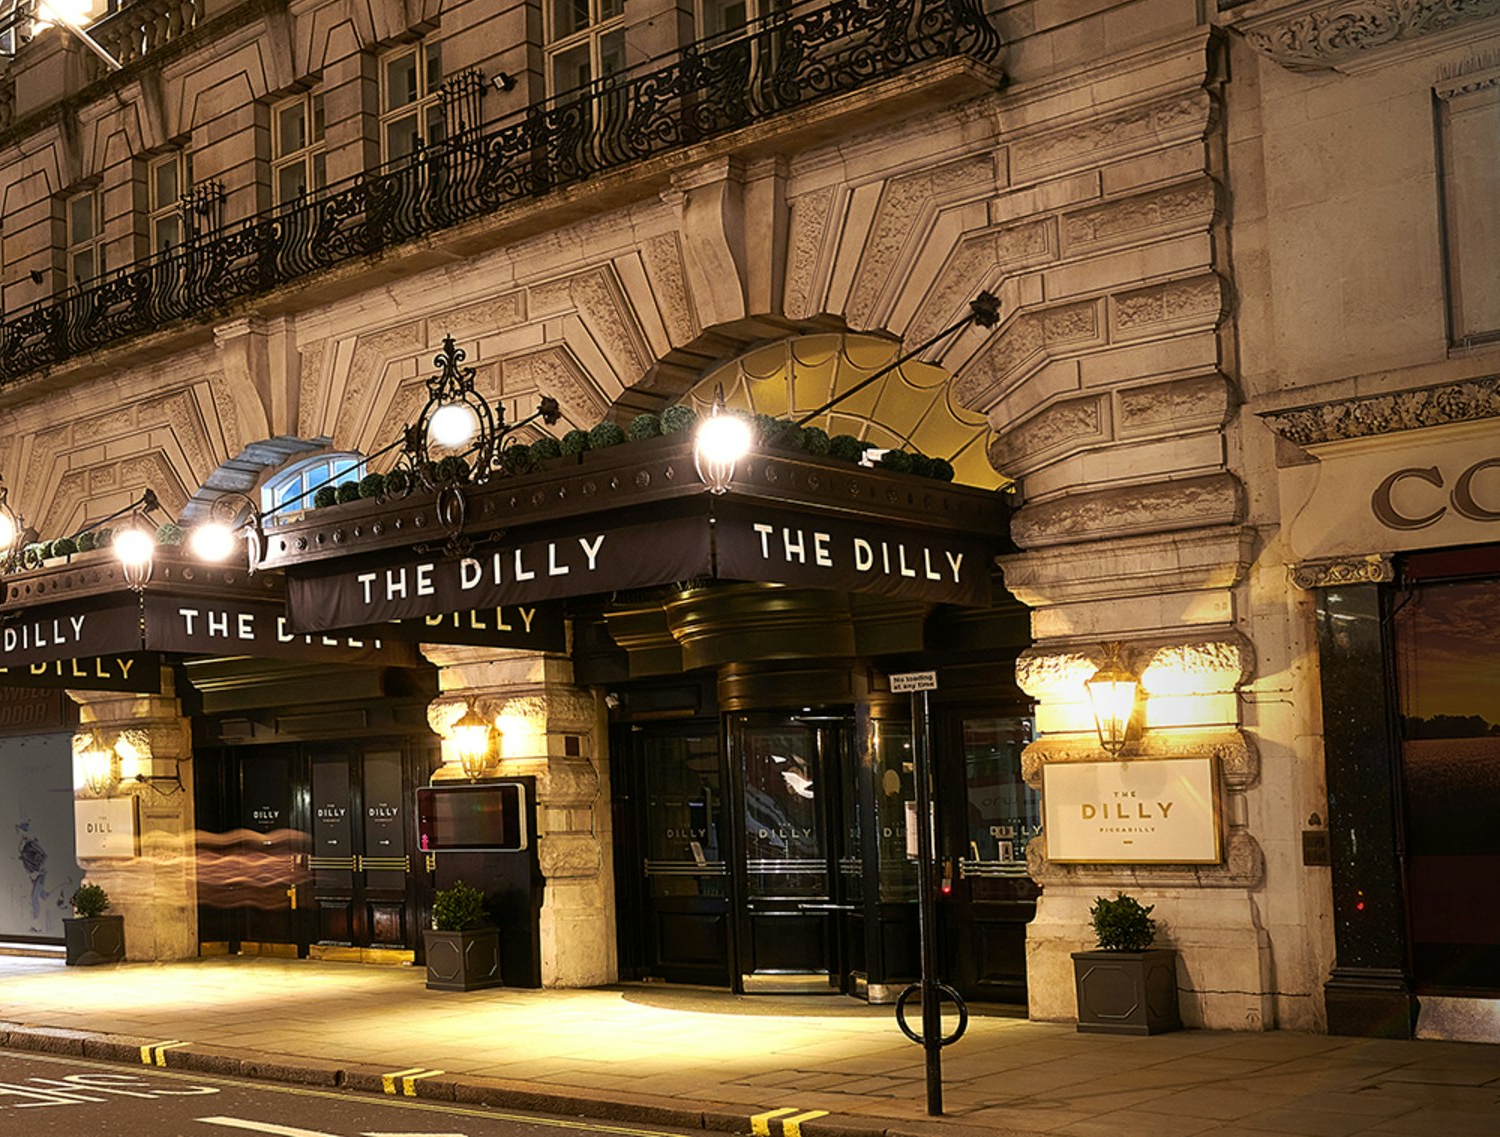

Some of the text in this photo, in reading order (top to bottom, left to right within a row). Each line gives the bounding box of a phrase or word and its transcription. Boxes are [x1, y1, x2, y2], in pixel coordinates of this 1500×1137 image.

[753, 523, 963, 583] THE DILLY
[358, 535, 605, 604] THE DILLY
[179, 608, 255, 640] THE
[4, 615, 85, 652] DILLY
[253, 811, 279, 819] DILLY
[317, 808, 346, 817] DILLY
[368, 808, 399, 817] DILLY
[1082, 802, 1173, 819] DILLY
[666, 828, 706, 839] DILLY
[758, 828, 811, 839] DILLY
